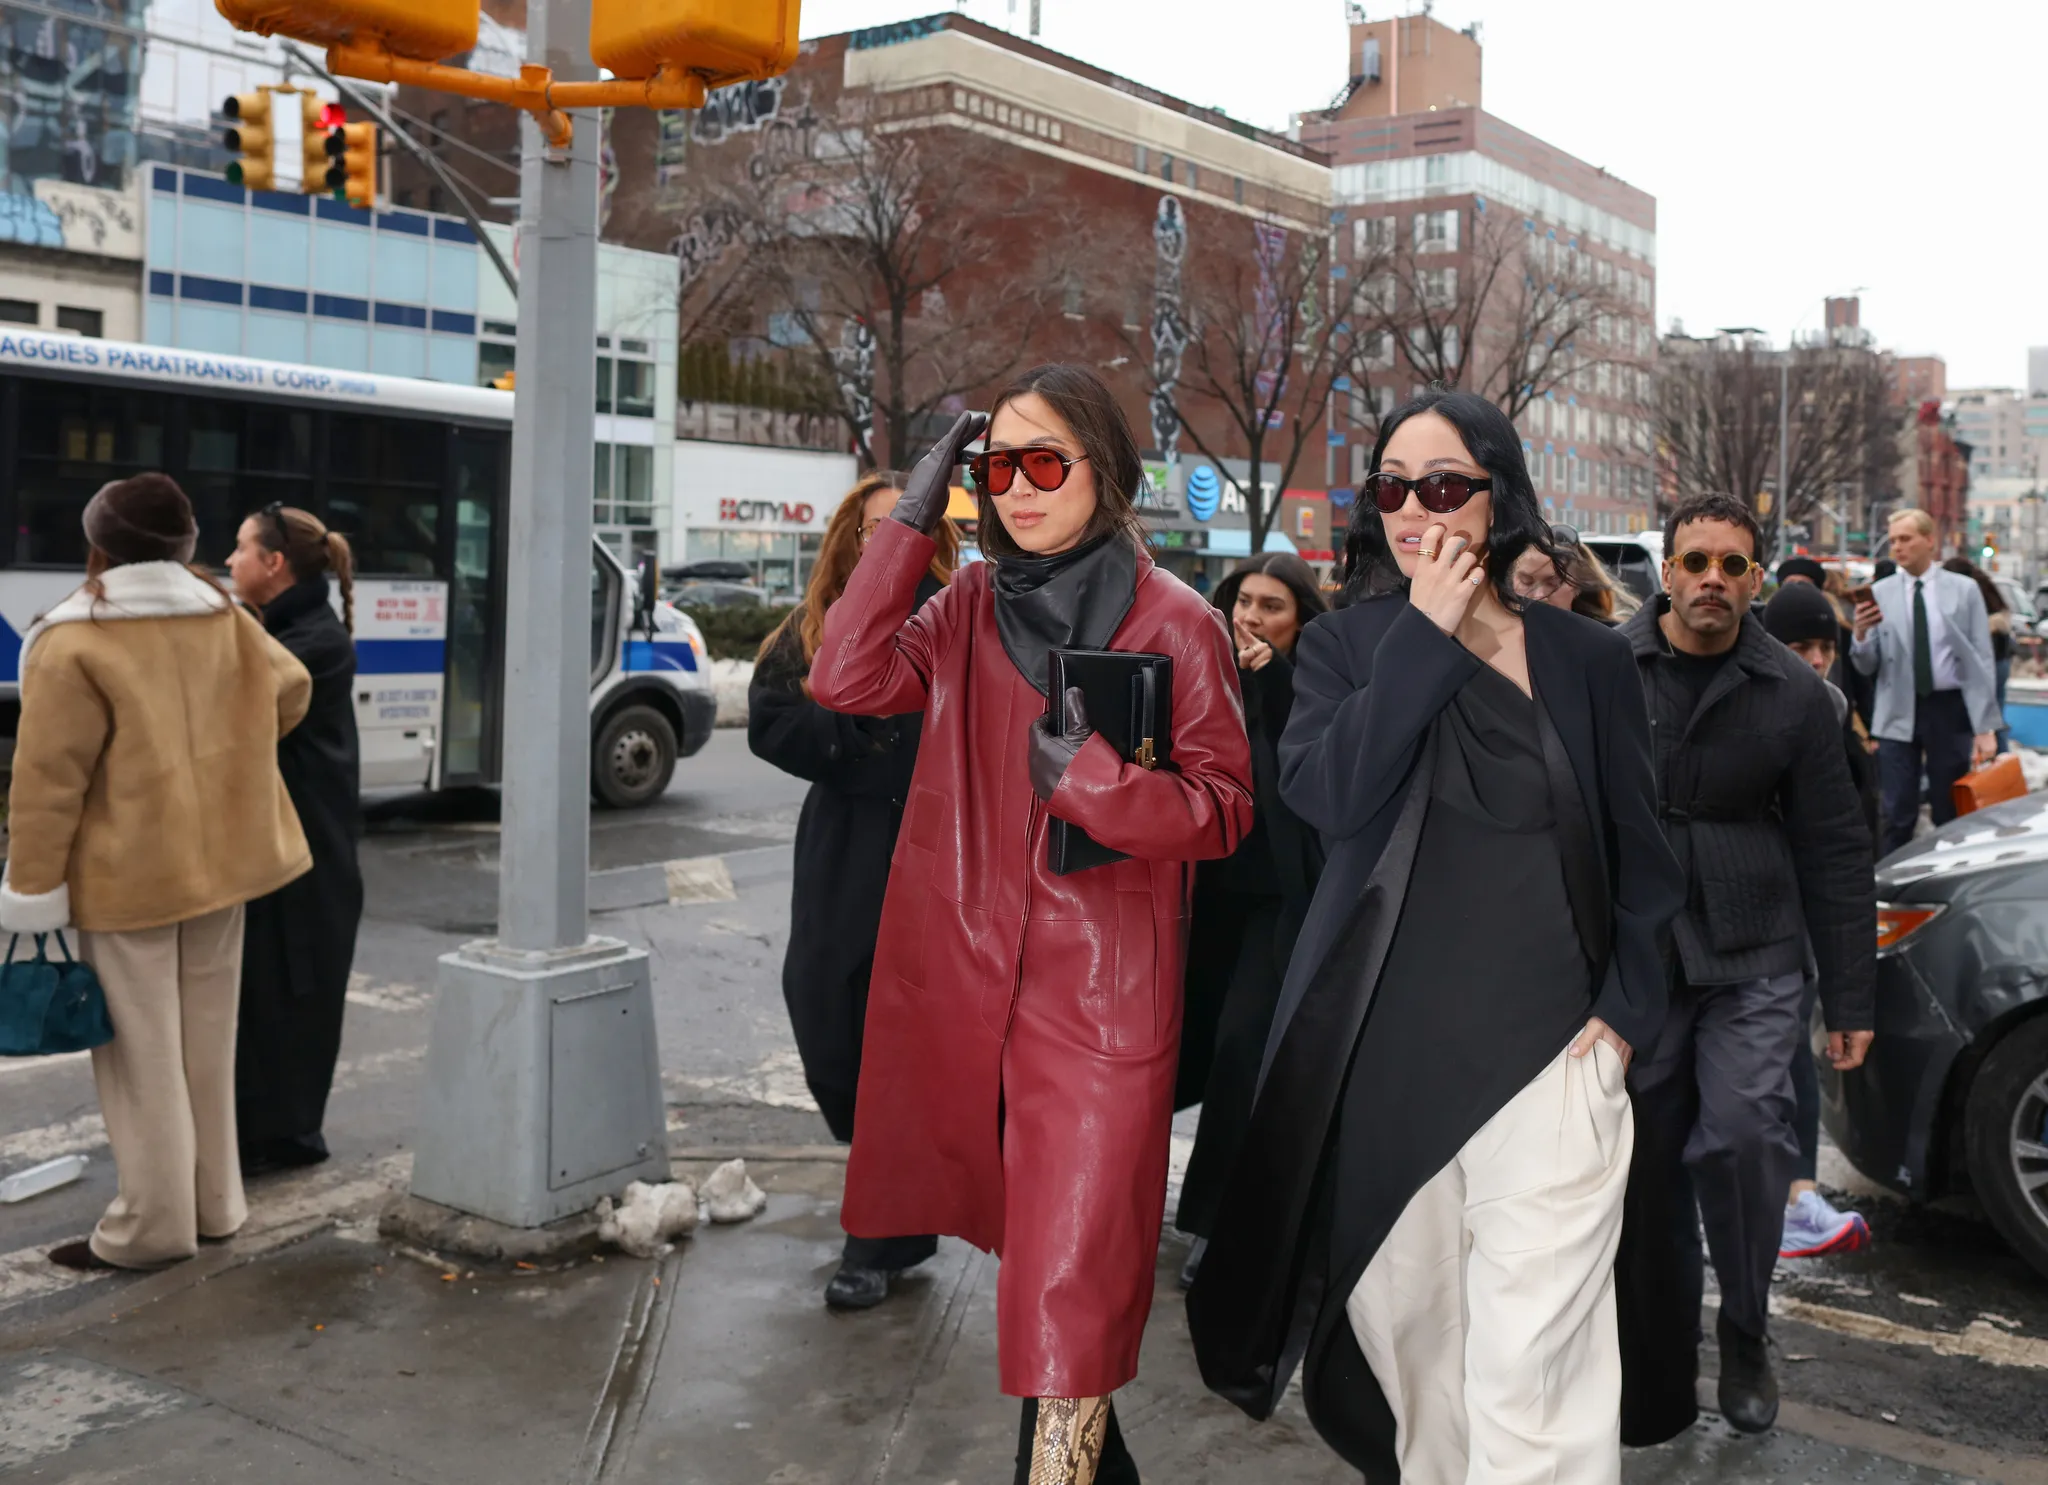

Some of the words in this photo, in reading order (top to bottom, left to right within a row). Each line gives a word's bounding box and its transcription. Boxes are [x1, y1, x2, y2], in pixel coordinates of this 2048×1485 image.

[0, 336, 99, 365] AGGIES
[108, 348, 264, 384] PARATRANSIT
[737, 499, 814, 522] CITYMD
[1221, 480, 1275, 513] ATT
